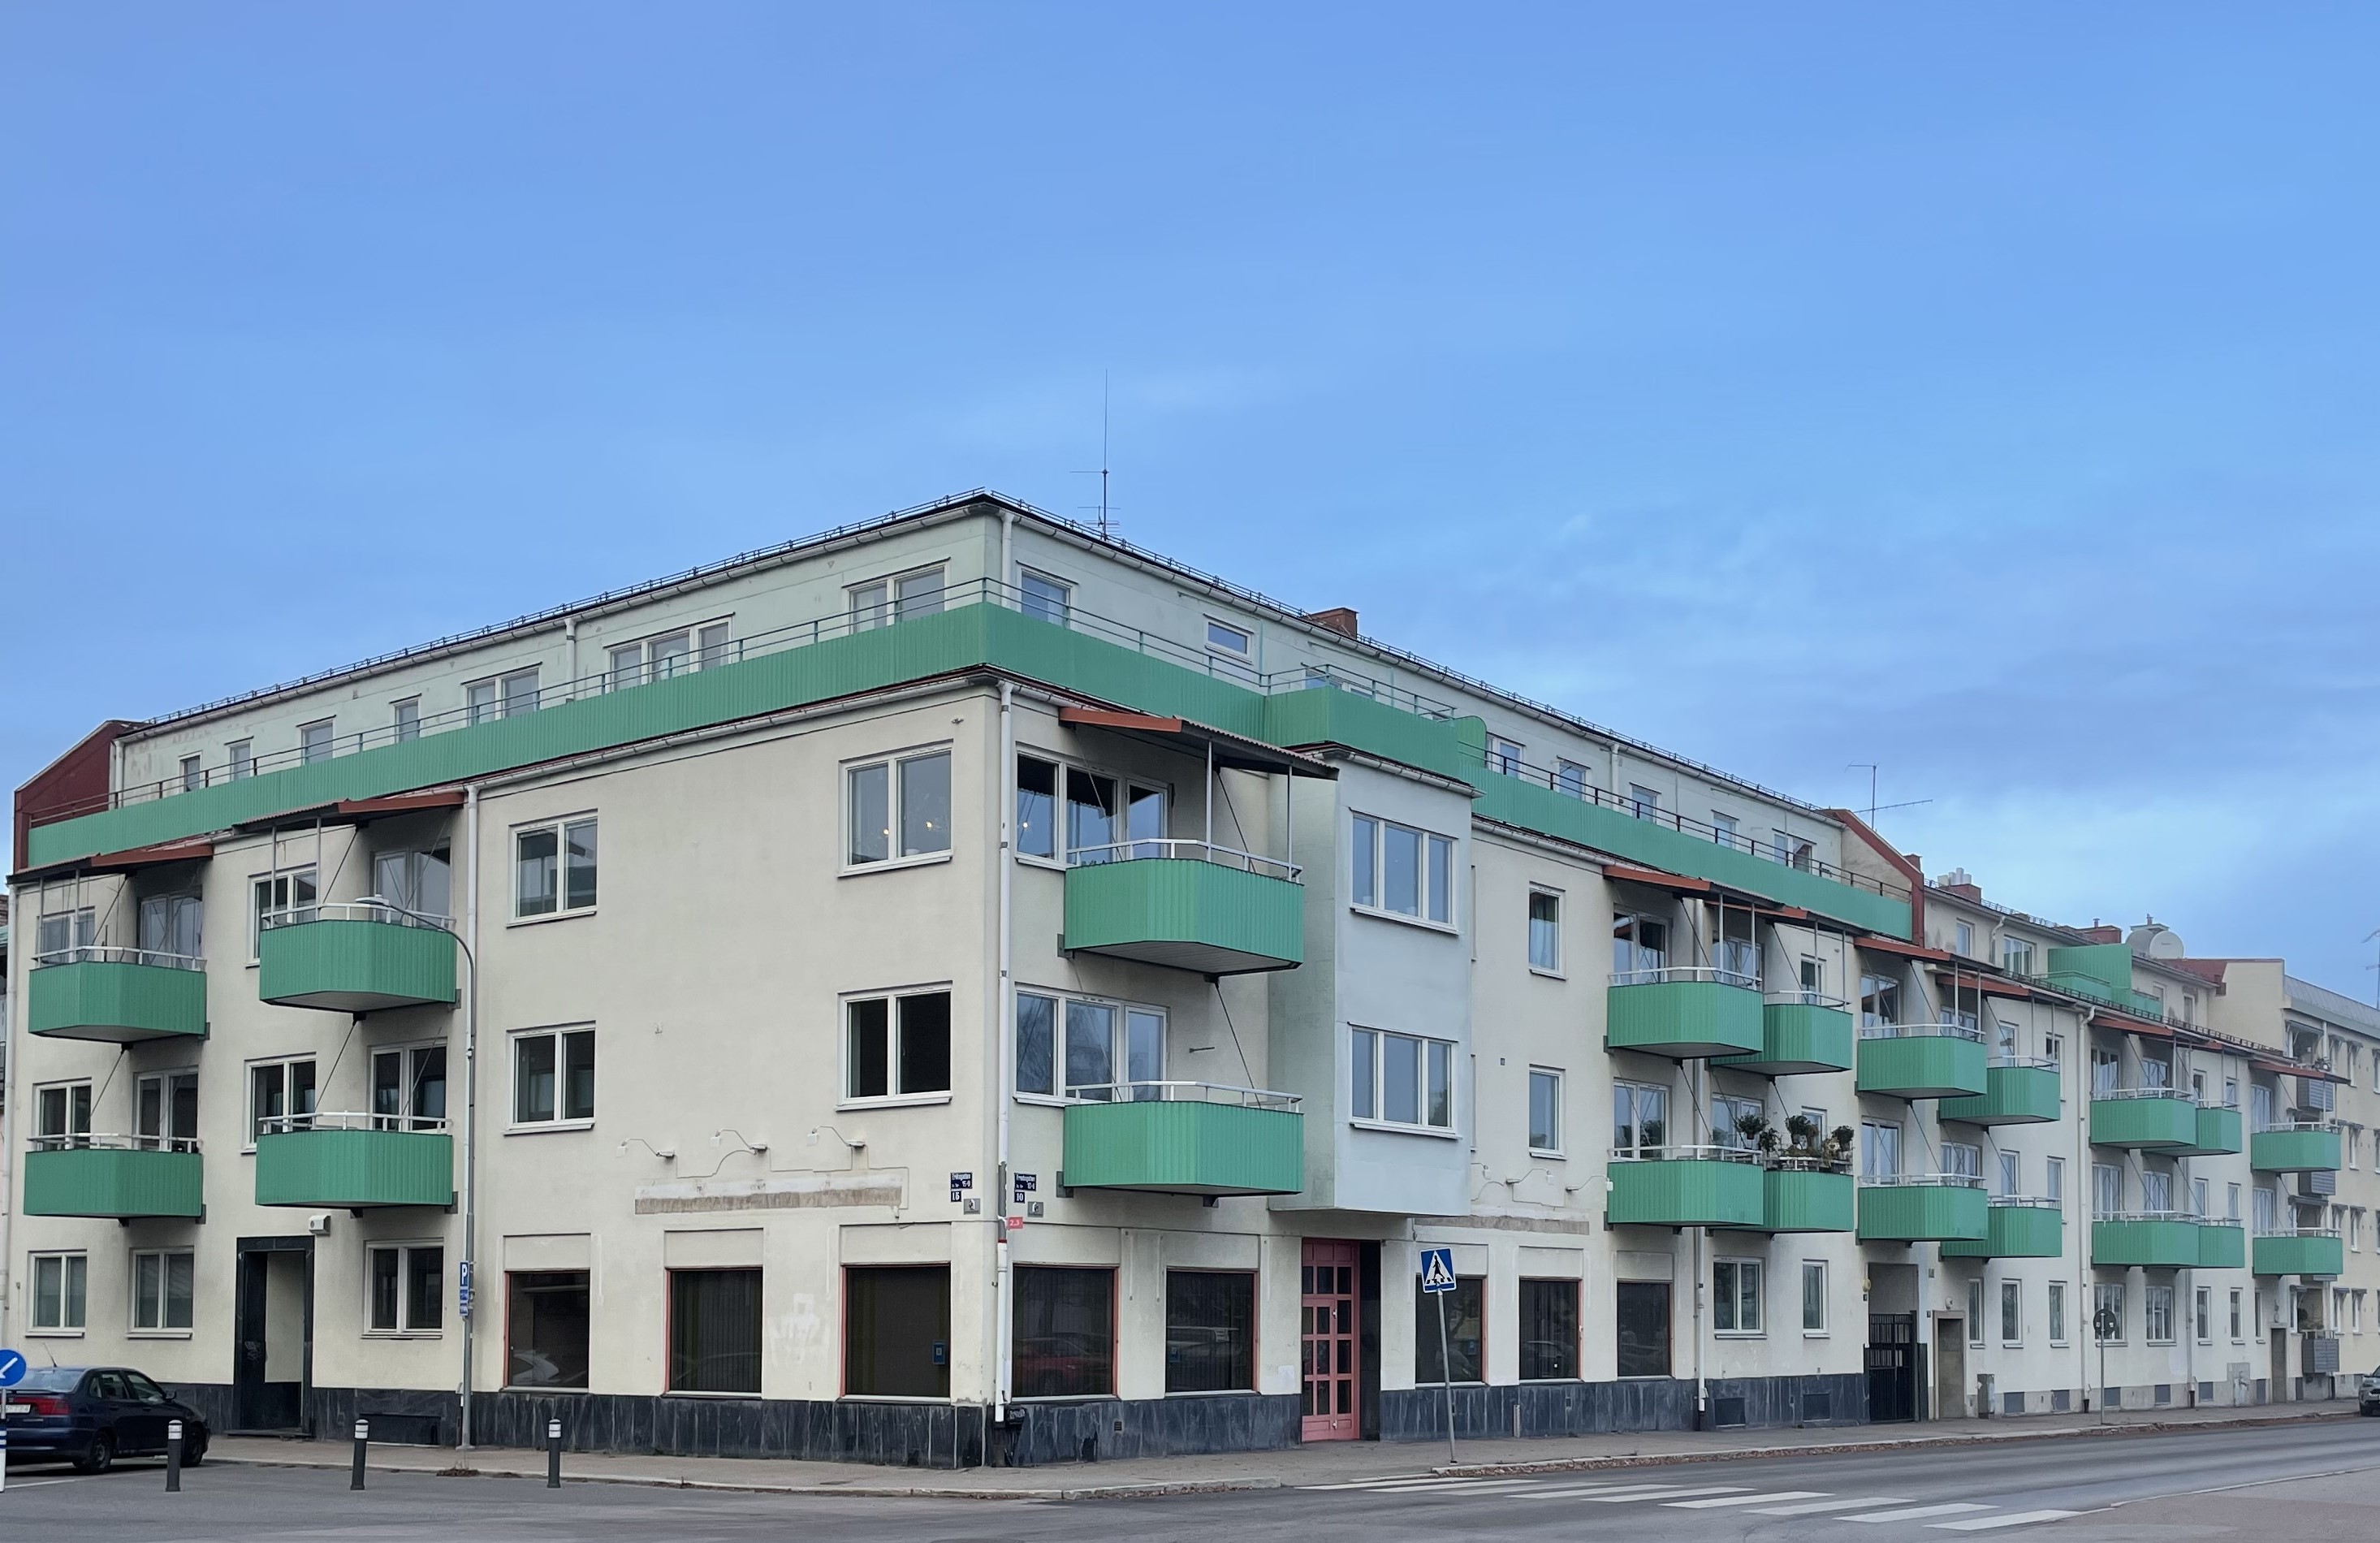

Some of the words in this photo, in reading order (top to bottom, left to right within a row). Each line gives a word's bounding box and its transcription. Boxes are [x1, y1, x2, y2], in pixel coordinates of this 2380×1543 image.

[952, 1192, 960, 1200] 15
[1016, 1193, 1023, 1201] 10
[462, 1264, 467, 1285] P
